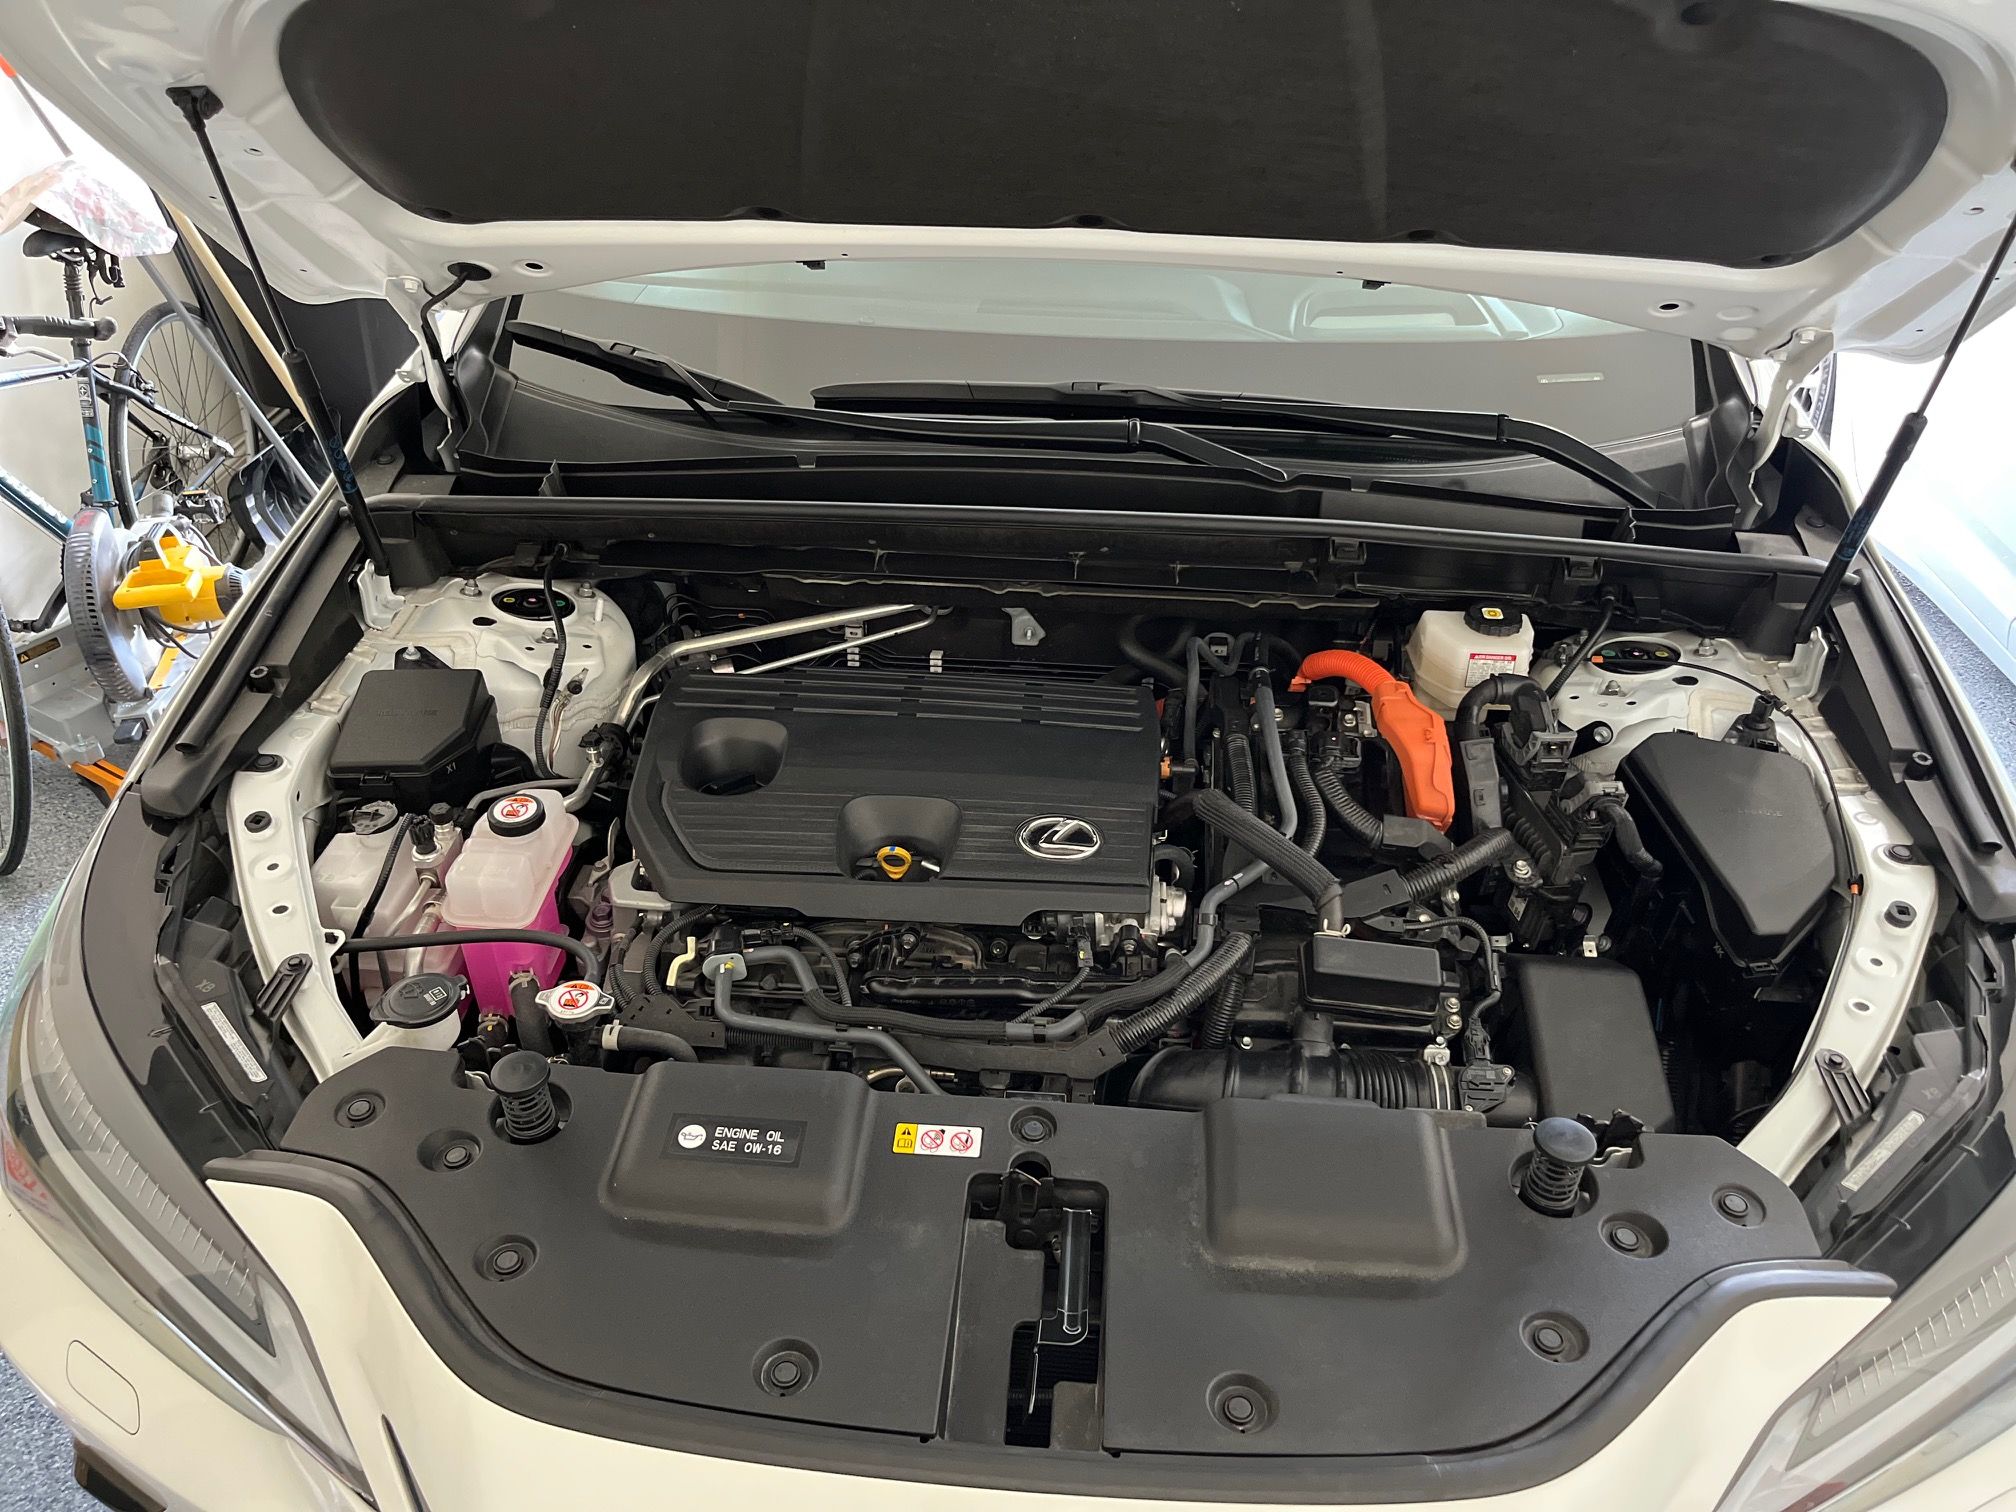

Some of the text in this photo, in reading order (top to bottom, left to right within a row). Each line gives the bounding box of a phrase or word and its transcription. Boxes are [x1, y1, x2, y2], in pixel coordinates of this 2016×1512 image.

[714, 1126, 785, 1142] ENGINE OIL
[711, 1139, 782, 1155] SAE 0W-16
